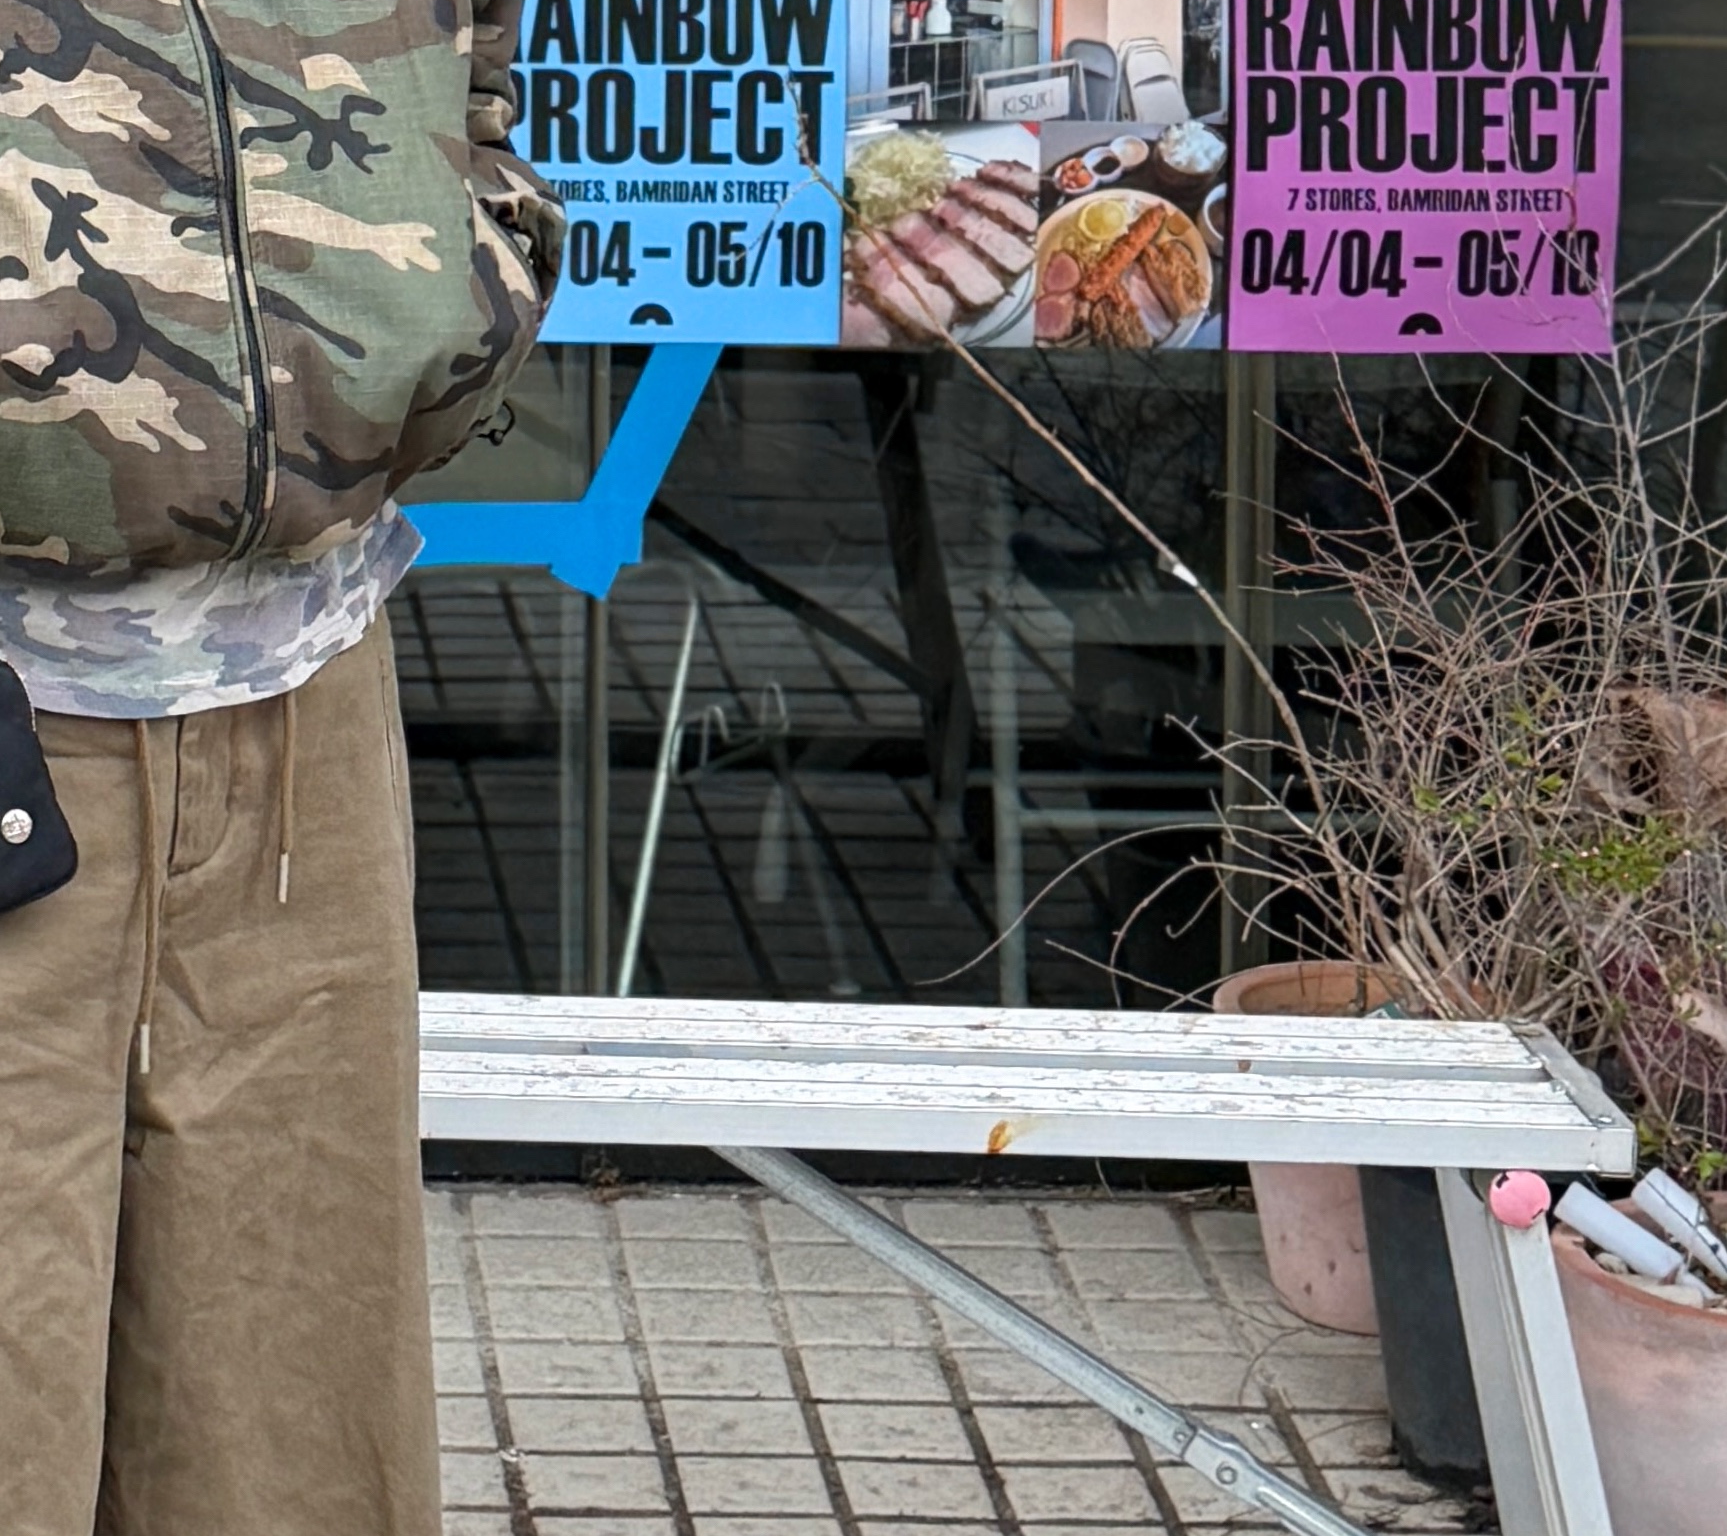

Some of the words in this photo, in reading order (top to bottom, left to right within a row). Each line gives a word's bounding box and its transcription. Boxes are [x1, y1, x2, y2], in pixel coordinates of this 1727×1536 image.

[1002, 89, 1054, 117] KISUKI
[1246, 75, 1609, 174] PROJECT
[615, 180, 717, 203] BAMRIDAN
[722, 180, 790, 204] STREET
[1287, 188, 1298, 212] 7
[1387, 189, 1491, 213] BAMRIDAN
[1496, 189, 1564, 212] STREET
[686, 220, 826, 288] 05/10
[1457, 229, 1600, 297] 05/10
